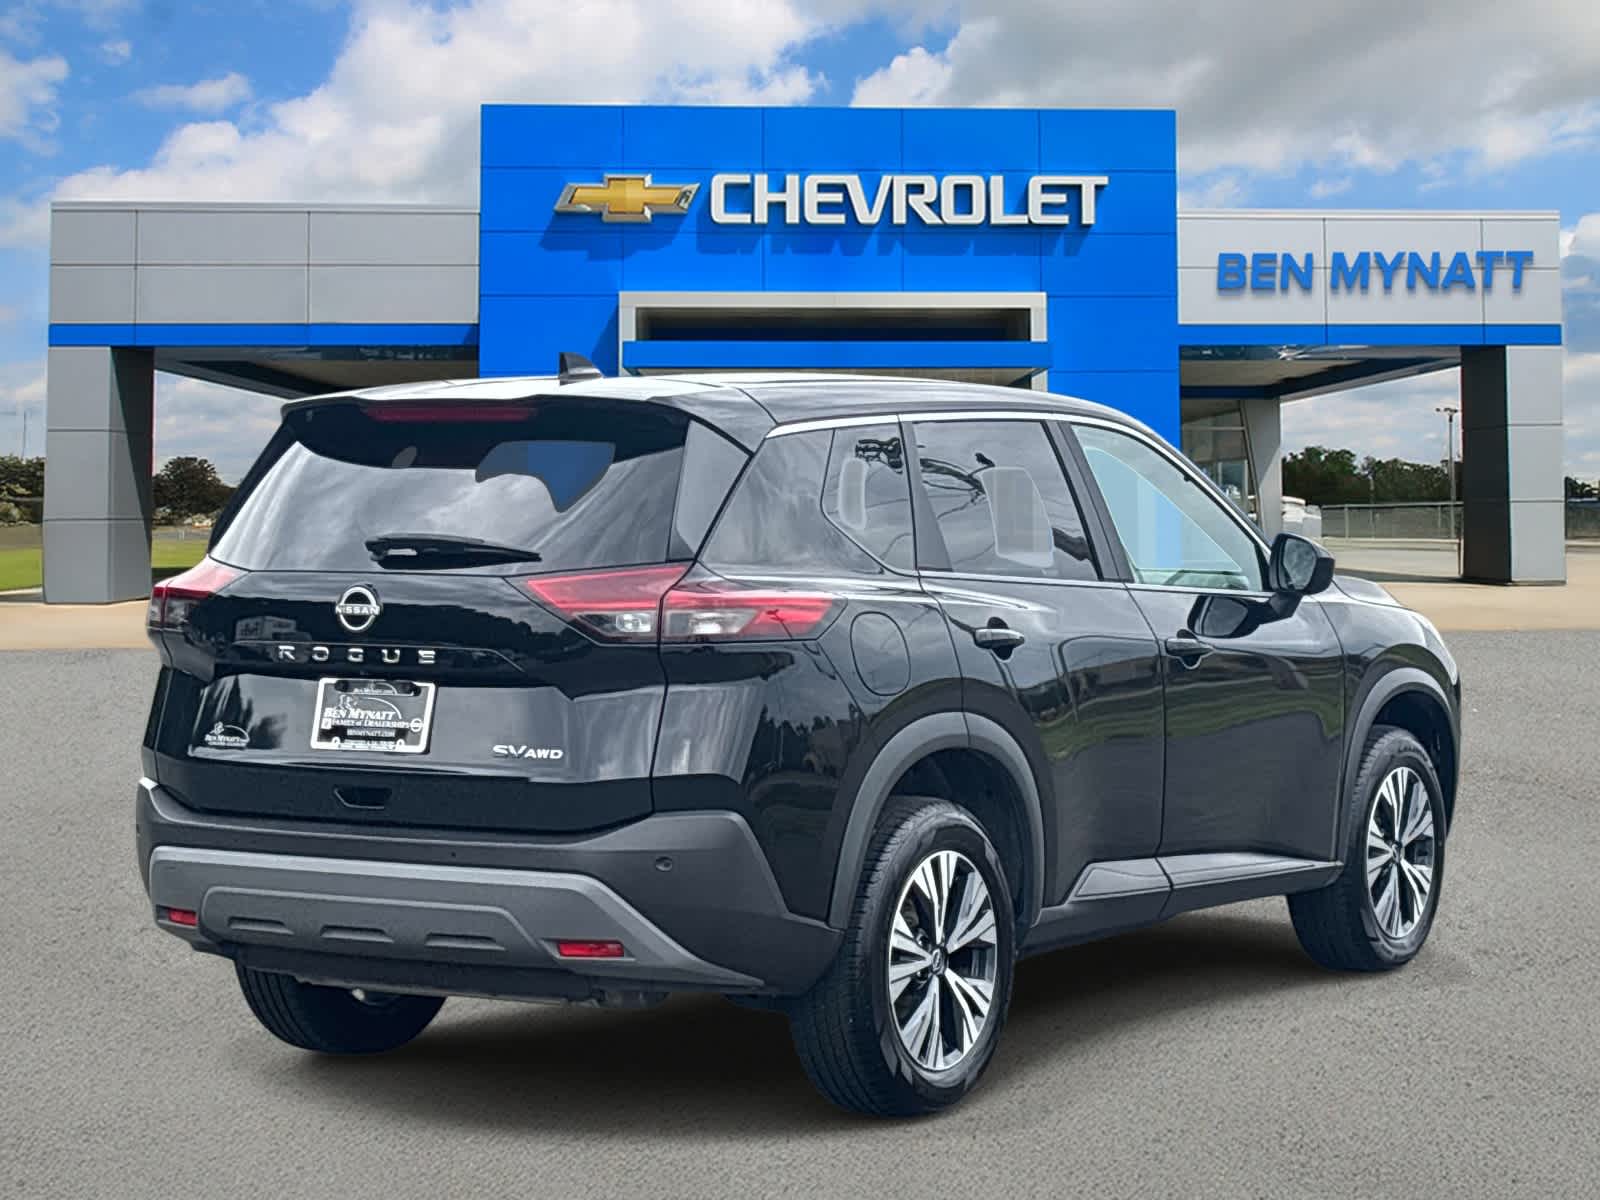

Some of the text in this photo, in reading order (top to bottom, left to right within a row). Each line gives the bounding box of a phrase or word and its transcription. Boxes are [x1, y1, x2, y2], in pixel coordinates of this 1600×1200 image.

[709, 173, 1109, 225] CHEVROLET
[1217, 250, 1534, 290] BEN MYNATT
[335, 604, 380, 616] NISSAN
[278, 645, 436, 664] ROGUE
